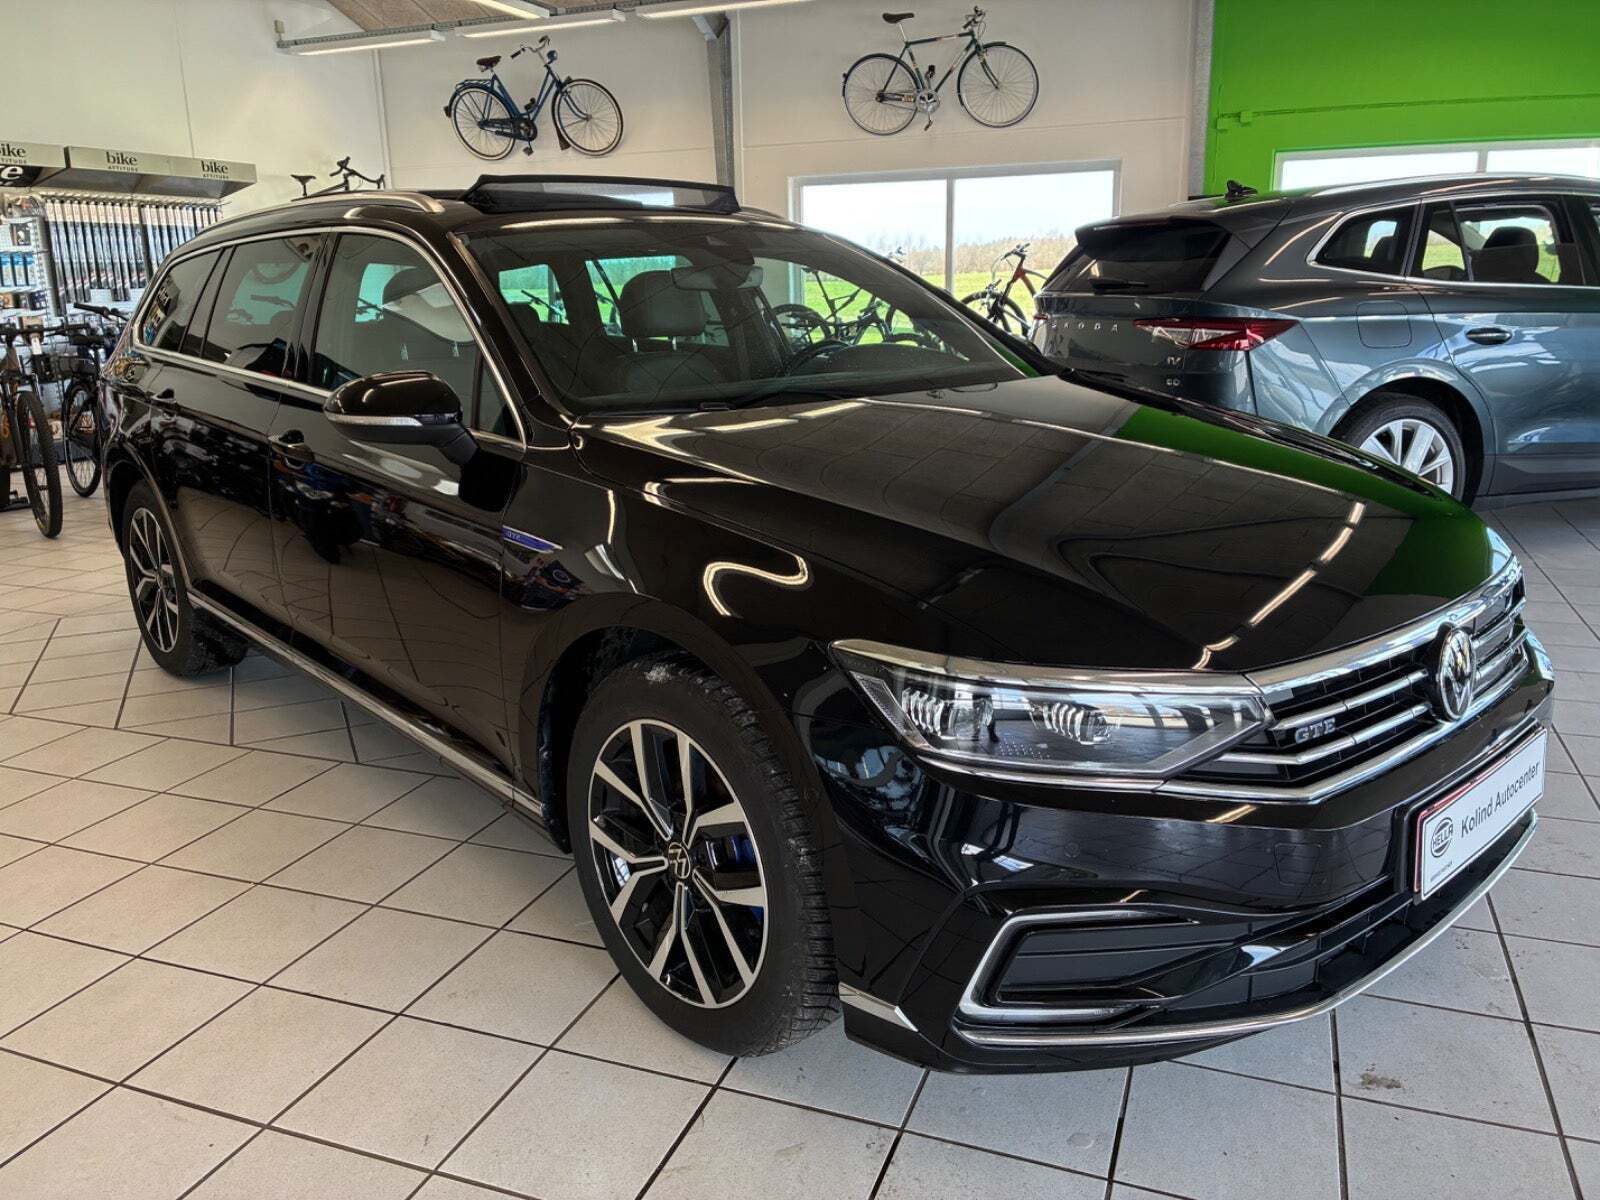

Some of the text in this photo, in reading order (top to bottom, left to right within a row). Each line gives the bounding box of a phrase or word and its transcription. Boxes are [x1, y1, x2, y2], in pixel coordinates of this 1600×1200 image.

[0, 143, 26, 158] ike
[106, 151, 138, 166] bike
[107, 164, 139, 172] ATTITUDE
[201, 160, 229, 174] bike
[1294, 716, 1336, 744] GTE
[1461, 761, 1540, 838] Kolind Autocenter
[1431, 823, 1453, 849] HELLA
